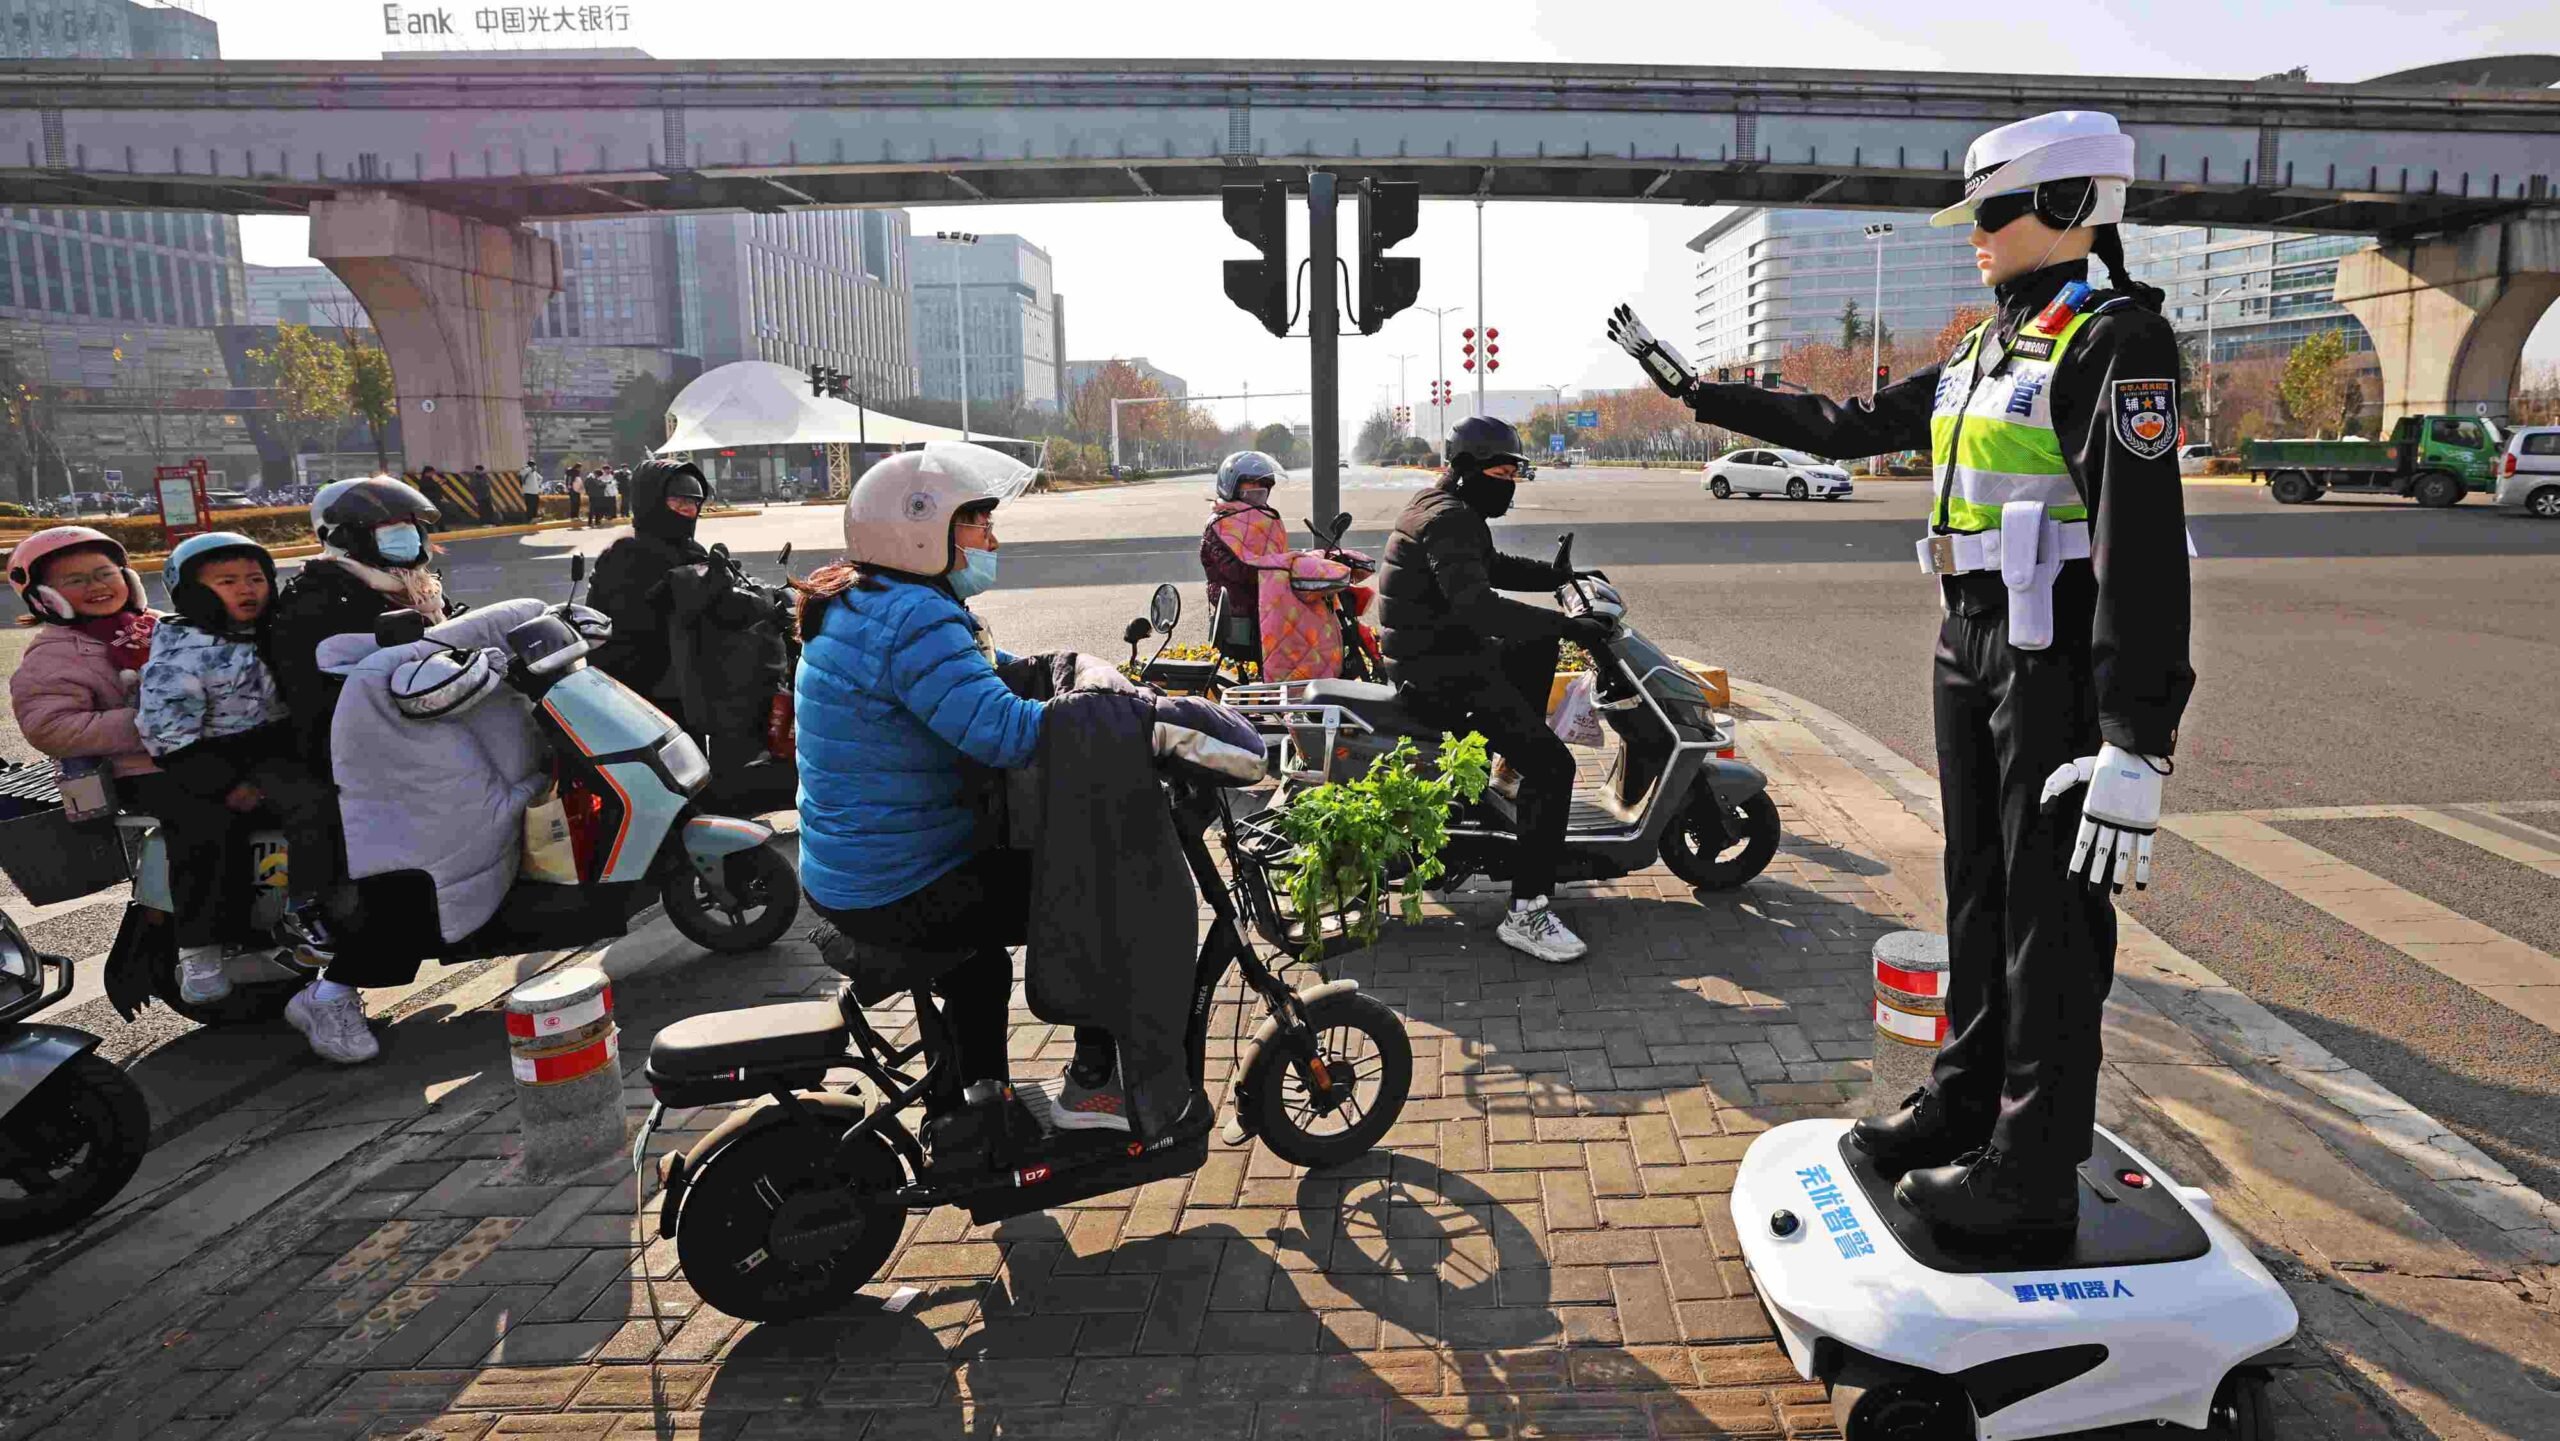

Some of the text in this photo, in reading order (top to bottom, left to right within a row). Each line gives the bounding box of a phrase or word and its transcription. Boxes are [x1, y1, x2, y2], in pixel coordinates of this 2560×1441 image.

[475, 5, 630, 33] 中国光大银行
[2125, 395, 2166, 411] 辅 警
[1194, 985, 1208, 1015] YADEA
[1795, 1164, 1876, 1259] 芜优智警
[2012, 1279, 2135, 1303] 墨甲机器人
